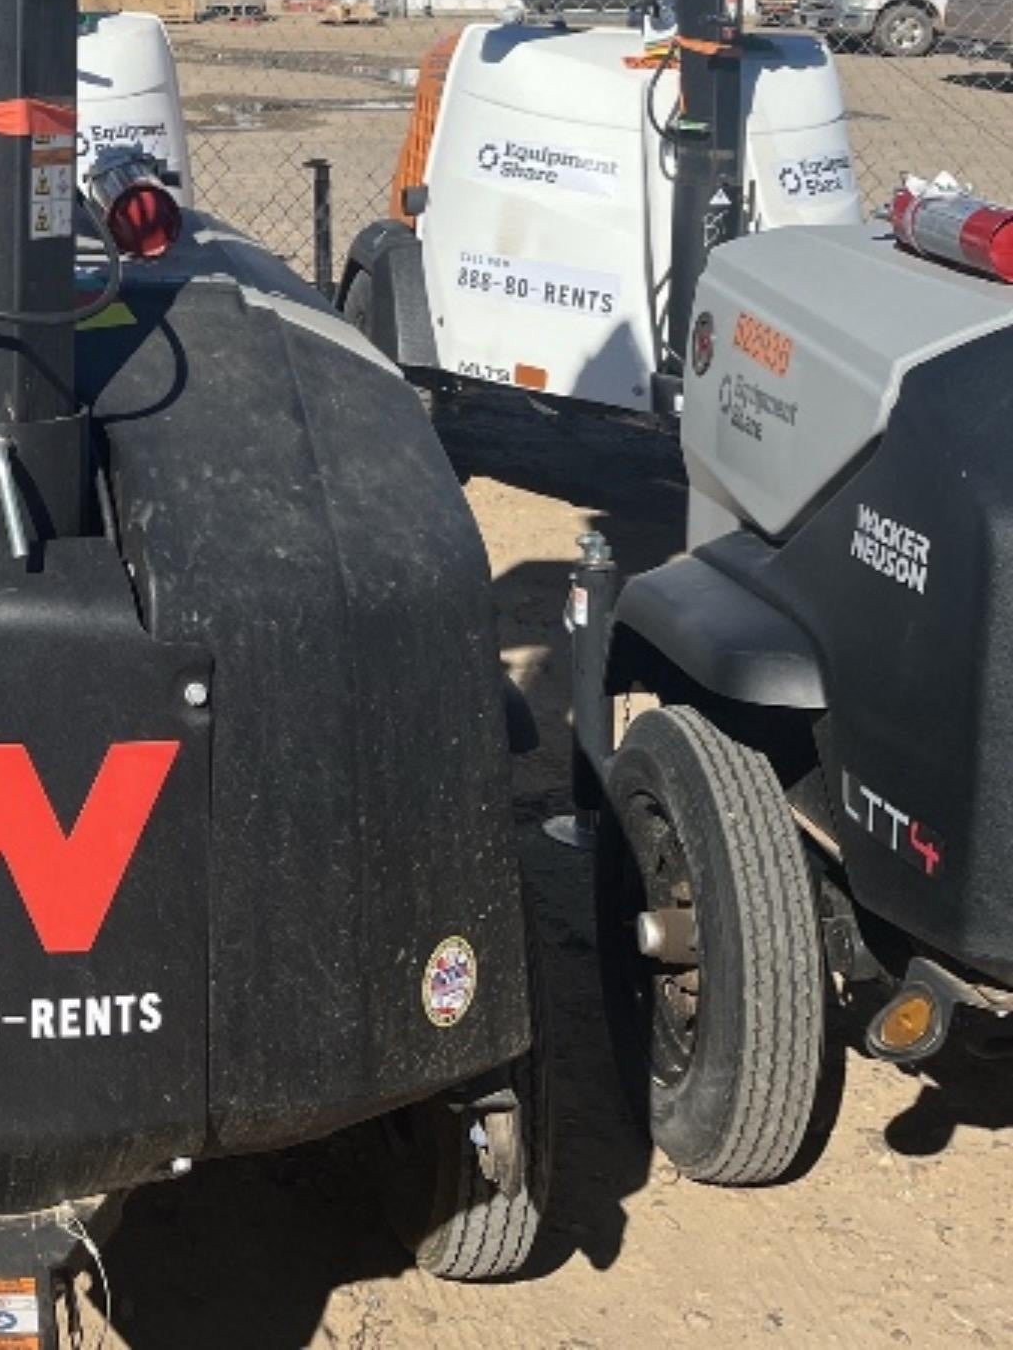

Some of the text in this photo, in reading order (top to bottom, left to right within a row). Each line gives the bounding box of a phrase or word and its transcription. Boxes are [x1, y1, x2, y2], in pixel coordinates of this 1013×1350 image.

[499, 161, 559, 184] Share
[503, 141, 618, 176] Equipment
[850, 530, 928, 595] NEUSON
[857, 503, 930, 565] WACKER
[842, 766, 939, 875] LTT4
